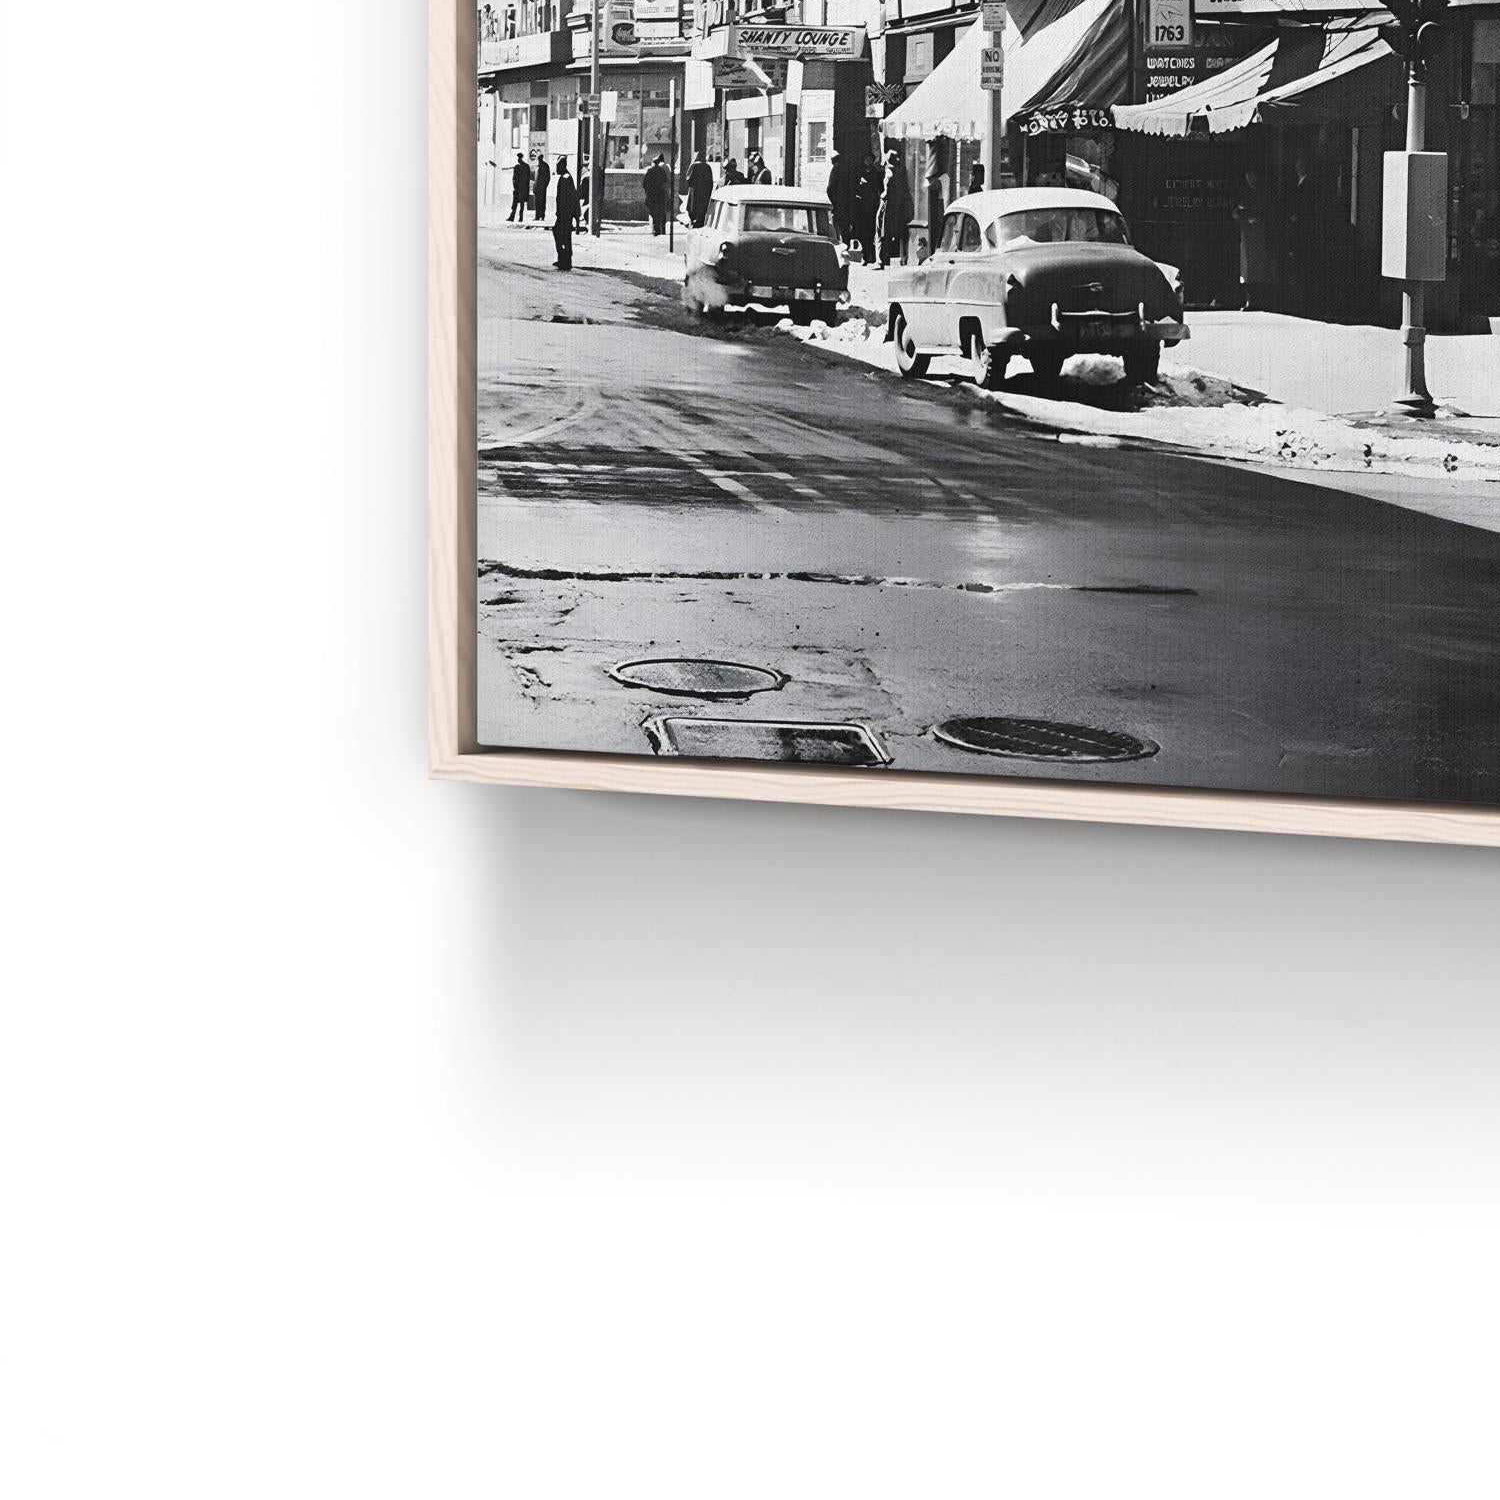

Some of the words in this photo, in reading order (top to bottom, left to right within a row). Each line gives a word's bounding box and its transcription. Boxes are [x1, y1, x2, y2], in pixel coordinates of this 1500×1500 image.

[738, 30, 792, 47] SHANTY
[794, 31, 850, 46] LOUNGE
[1154, 24, 1185, 42] 1763
[984, 50, 1000, 62] NO
